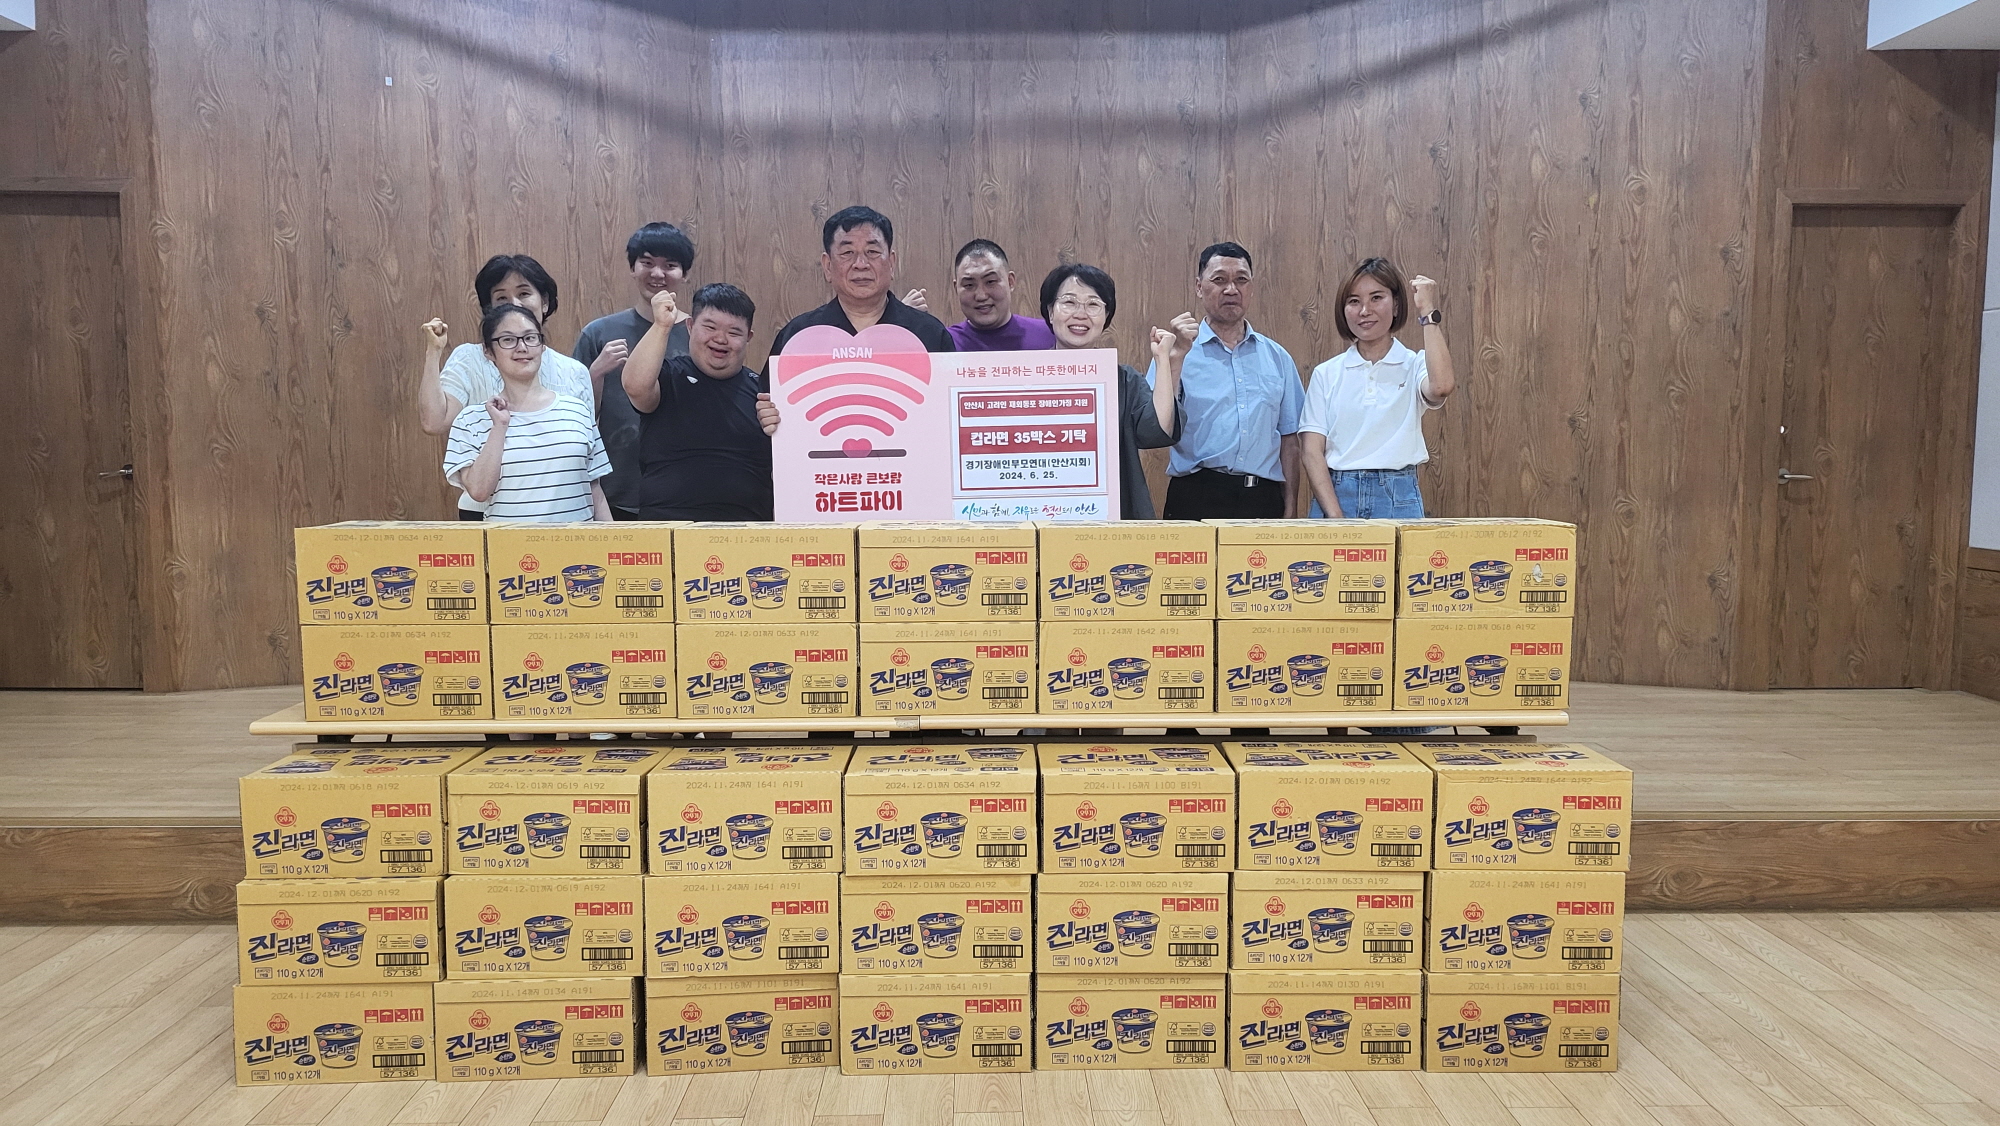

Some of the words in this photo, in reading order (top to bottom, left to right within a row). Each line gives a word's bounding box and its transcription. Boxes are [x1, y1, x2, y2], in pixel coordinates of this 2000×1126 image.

[832, 347, 872, 359] ANSAN
[957, 367, 987, 377] 나눔을
[991, 366, 1032, 376] 전파하는
[1036, 365, 1097, 376] 따뜻한에너지
[987, 401, 1006, 409] 고려인
[971, 432, 1009, 446] 컵라면
[1014, 431, 1056, 444] 35박스
[1061, 430, 1087, 443] 기탁
[815, 473, 862, 485] 작은사랑
[867, 472, 902, 484] 큰보람
[1000, 472, 1026, 480] 2024.
[1043, 471, 1058, 479] 25.
[815, 490, 902, 512] 하트파이
[962, 502, 990, 520] 시민과
[1075, 503, 1099, 515] 안산
[305, 576, 368, 605] 진라면
[498, 574, 559, 603] 진라면
[683, 576, 743, 604] 진라면
[869, 574, 927, 602] 진라면
[1048, 574, 1106, 602] 진라면
[1225, 570, 1284, 598] 진라면
[1406, 570, 1466, 598] 진라면
[334, 611, 346, 619] 110
[362, 610, 378, 620] 12개
[312, 673, 375, 701] 진라면
[502, 673, 563, 701] 진라면
[686, 672, 746, 700] 진라면
[870, 668, 928, 696] 진라면
[1047, 668, 1104, 695] 진라면
[1226, 664, 1284, 692] 진라면
[1403, 664, 1462, 692] 진라면
[1072, 701, 1083, 709] 110
[1098, 700, 1113, 709] 12개
[252, 828, 318, 859] 진라면
[456, 822, 520, 853] 진라면
[658, 825, 722, 855] 진라면
[854, 823, 917, 853] 진라면
[1053, 822, 1116, 852] 진라면
[1248, 819, 1312, 850] 진라면
[1443, 817, 1509, 849] 진라면
[882, 859, 893, 868] 110
[896, 861, 901, 869] g
[910, 858, 926, 868] 12개
[456, 926, 520, 956] 진라면
[655, 926, 719, 957] 진라면
[851, 923, 914, 953] 진라면
[1046, 920, 1109, 951] 진라면
[1241, 917, 1304, 948] 진라면
[1439, 923, 1503, 954] 진라면
[248, 932, 314, 963] 진라면
[1074, 957, 1085, 965] 110
[1088, 959, 1093, 967] g
[1102, 956, 1118, 966] 12개
[879, 959, 890, 968] 110
[892, 961, 897, 969] g
[907, 958, 923, 968] 12개
[446, 1031, 511, 1062] 진라면
[658, 1023, 722, 1055] 진라면
[850, 1023, 913, 1053] 진라면
[1046, 1018, 1108, 1048] 진라면
[1239, 1020, 1302, 1049] 진라면
[1436, 1022, 1500, 1052] 진라면
[244, 1034, 311, 1065] 진라면
[1266, 1056, 1278, 1064] 110
[1295, 1055, 1311, 1064] 12개
[474, 1067, 486, 1076] 110
[489, 1069, 494, 1077] g
[504, 1065, 520, 1075] 12개
